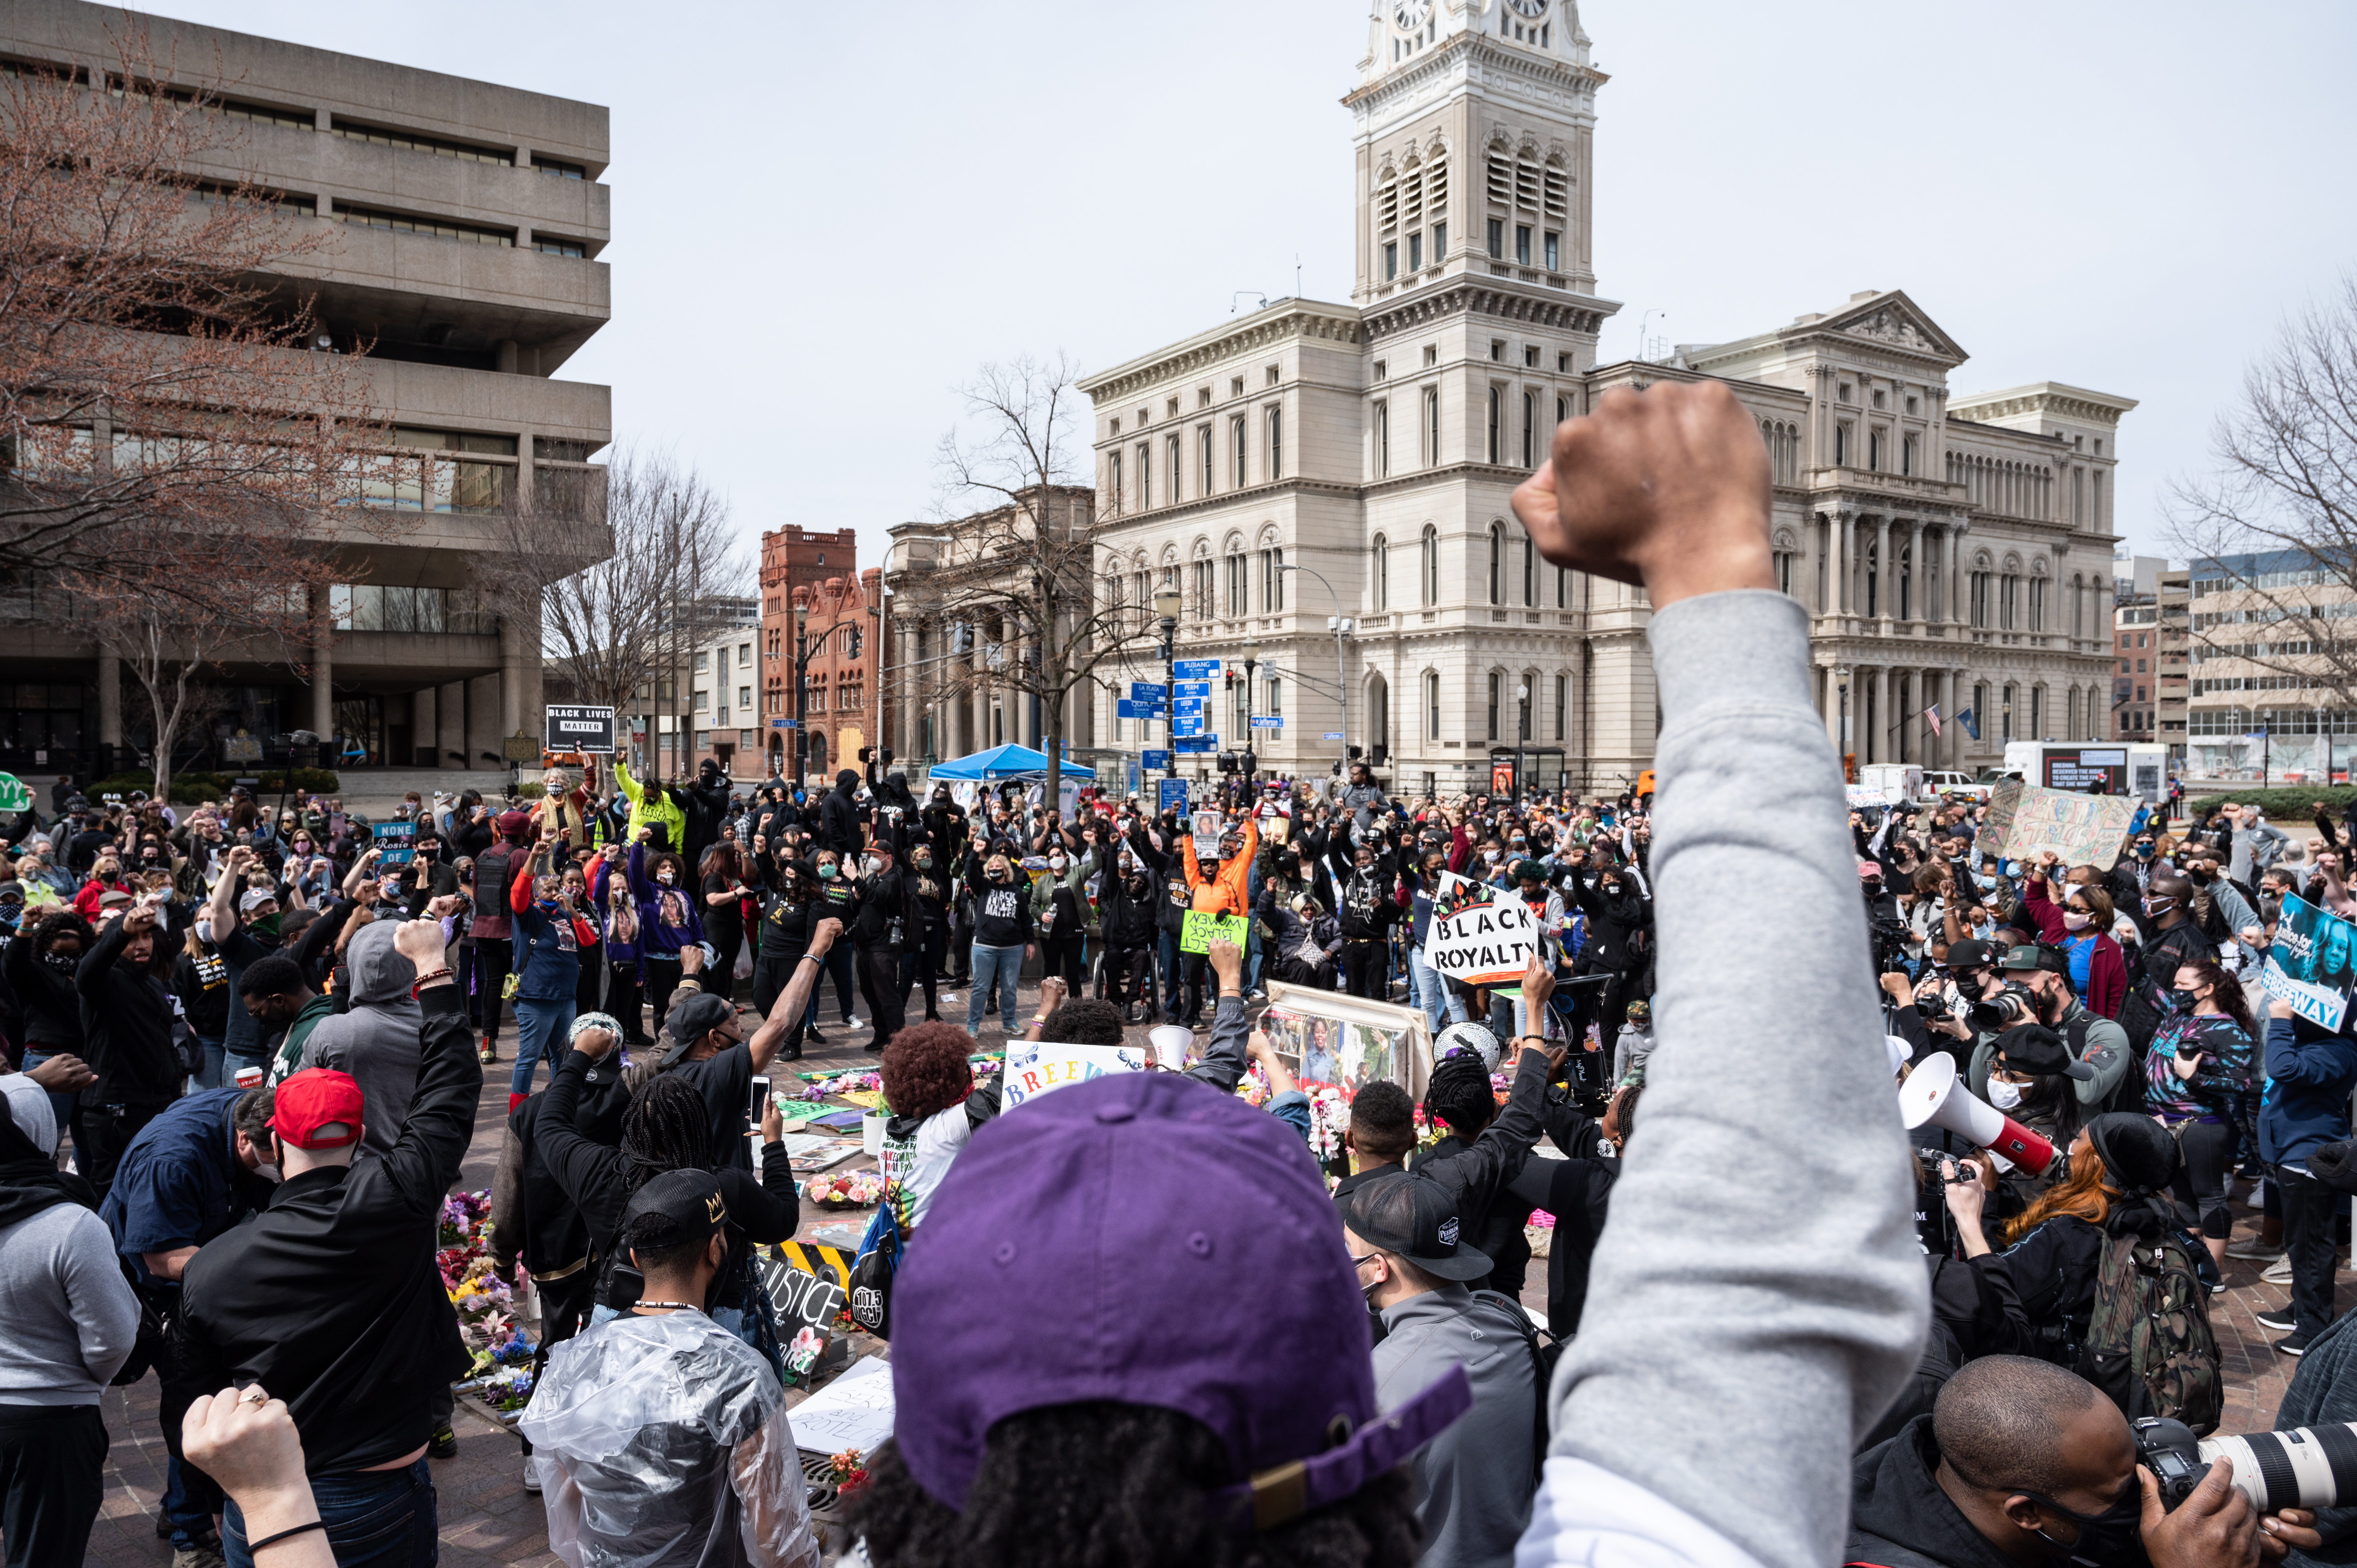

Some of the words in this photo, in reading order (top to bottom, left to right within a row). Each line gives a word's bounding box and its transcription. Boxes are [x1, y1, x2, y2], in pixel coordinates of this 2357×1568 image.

[1184, 661, 1211, 669] JIUJIANG
[549, 709, 579, 717] BLACK
[586, 710, 612, 719] LIVES
[1259, 718, 1278, 726] Jefferson
[639, 806, 667, 822] BLESSED
[880, 805, 903, 814] LOVE
[382, 825, 412, 836] NONE
[2024, 822, 2093, 847] TAYLOR
[374, 838, 408, 849] Rosie
[387, 853, 402, 862] OF
[987, 896, 1017, 907] LIVES
[990, 889, 1016, 901] BLACK
[985, 903, 1016, 919] MATTER
[1188, 912, 1242, 930] WOMEN
[1437, 908, 1531, 941] BLACK
[1189, 924, 1233, 942] BLACK
[2275, 923, 2298, 944] Justice
[2298, 933, 2313, 949] for
[1435, 942, 1535, 969] ROYALTY
[2262, 969, 2337, 1025] #BREEWAY
[767, 1262, 846, 1331] JUSTICE
[857, 1290, 883, 1306] 107.5
[774, 1312, 785, 1327] for
[853, 1305, 878, 1323] WGCI
[829, 1409, 869, 1421] and
